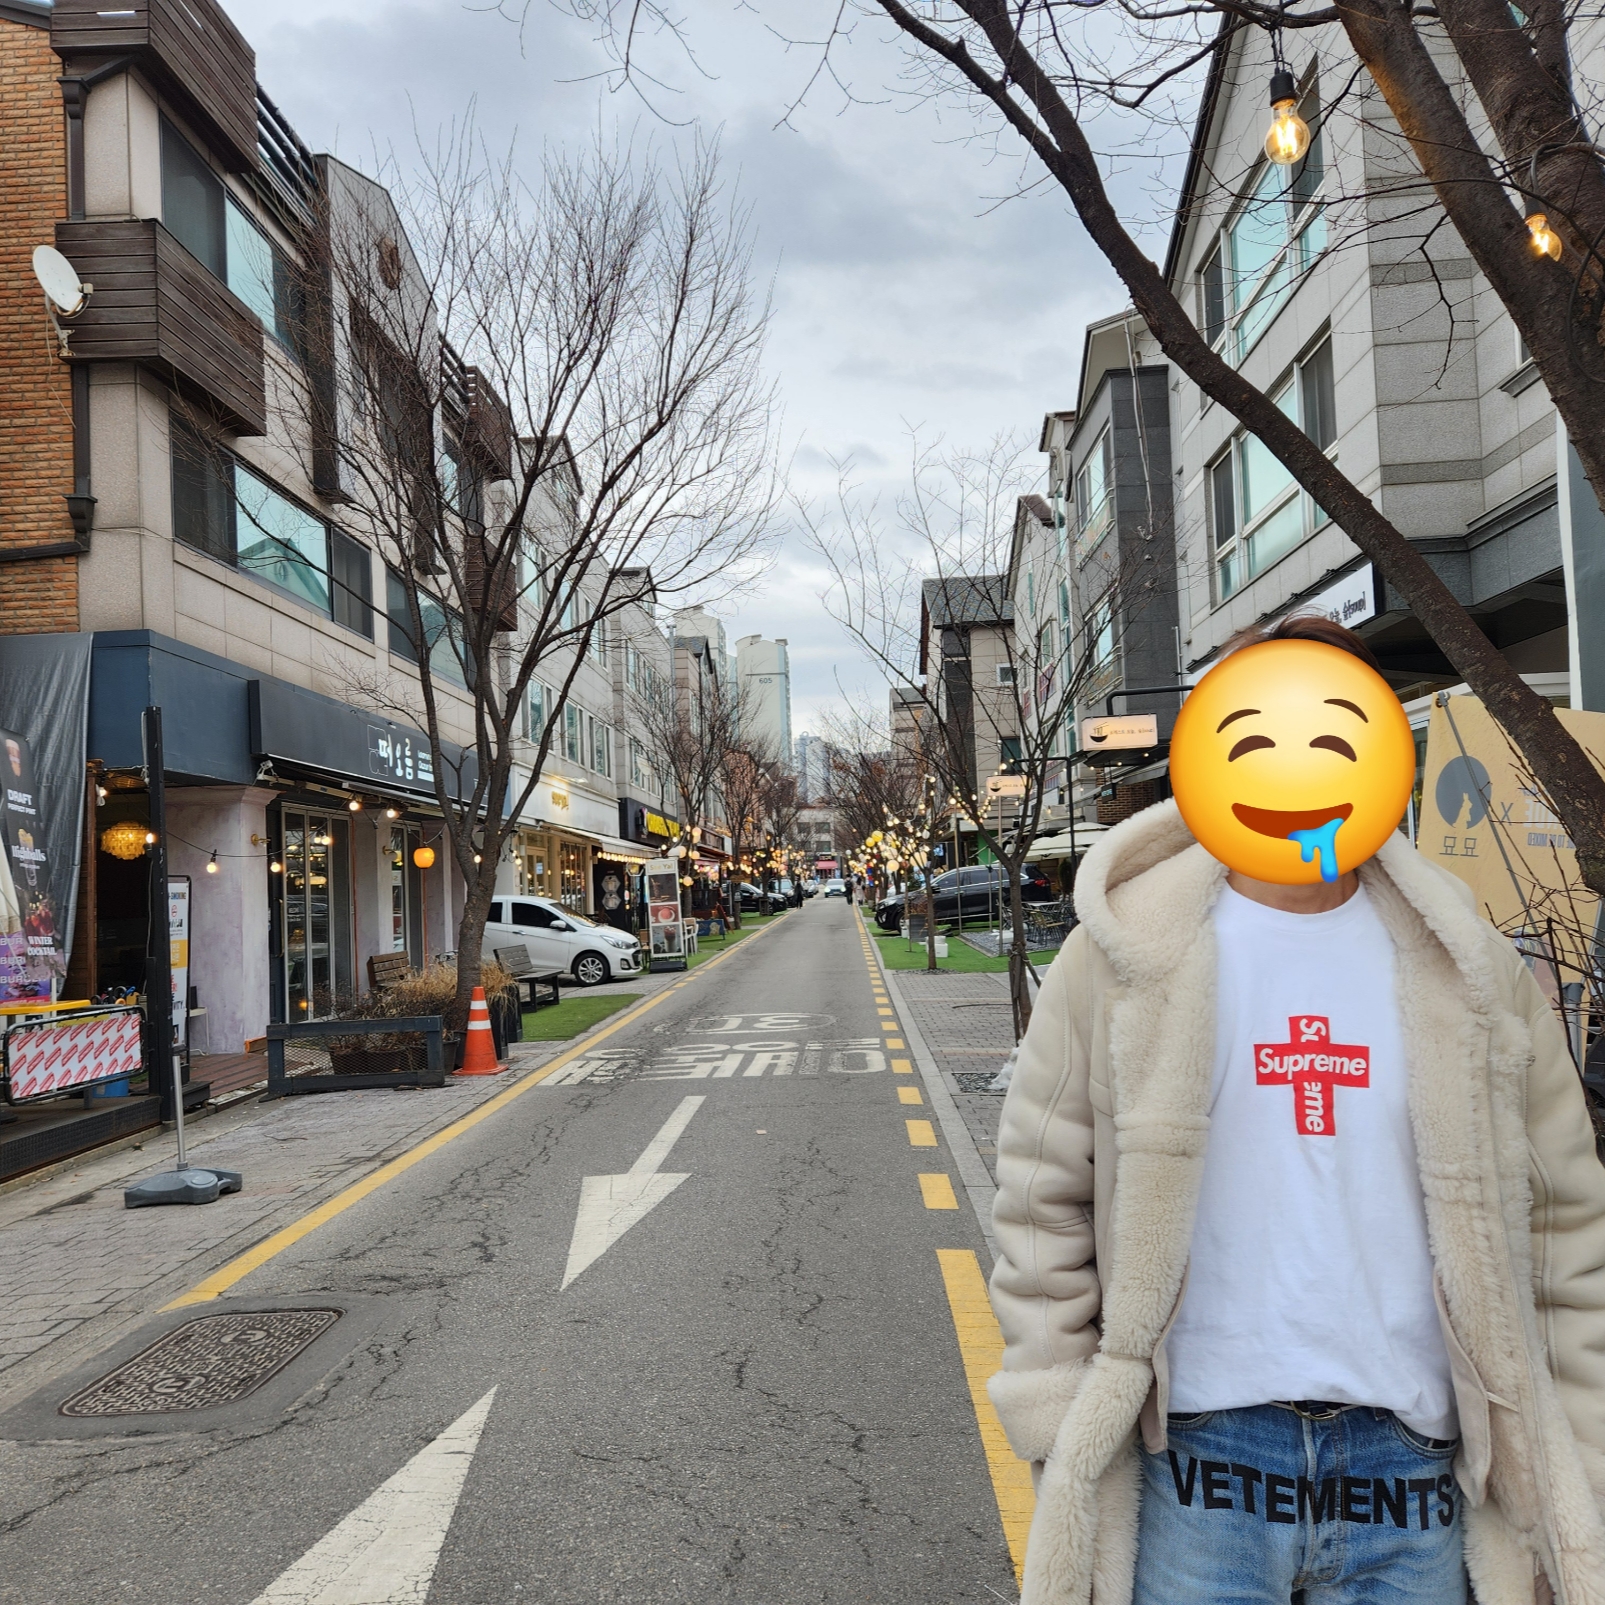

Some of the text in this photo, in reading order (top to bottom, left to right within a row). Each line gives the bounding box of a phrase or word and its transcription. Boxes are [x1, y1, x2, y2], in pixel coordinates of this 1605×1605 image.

[7, 789, 32, 805] DRAFT
[27, 935, 53, 945] WINTER
[27, 947, 57, 956] COCKTAIL
[1258, 1048, 1367, 1080] Supreme
[1168, 1449, 1455, 1531] VETEMENTS
